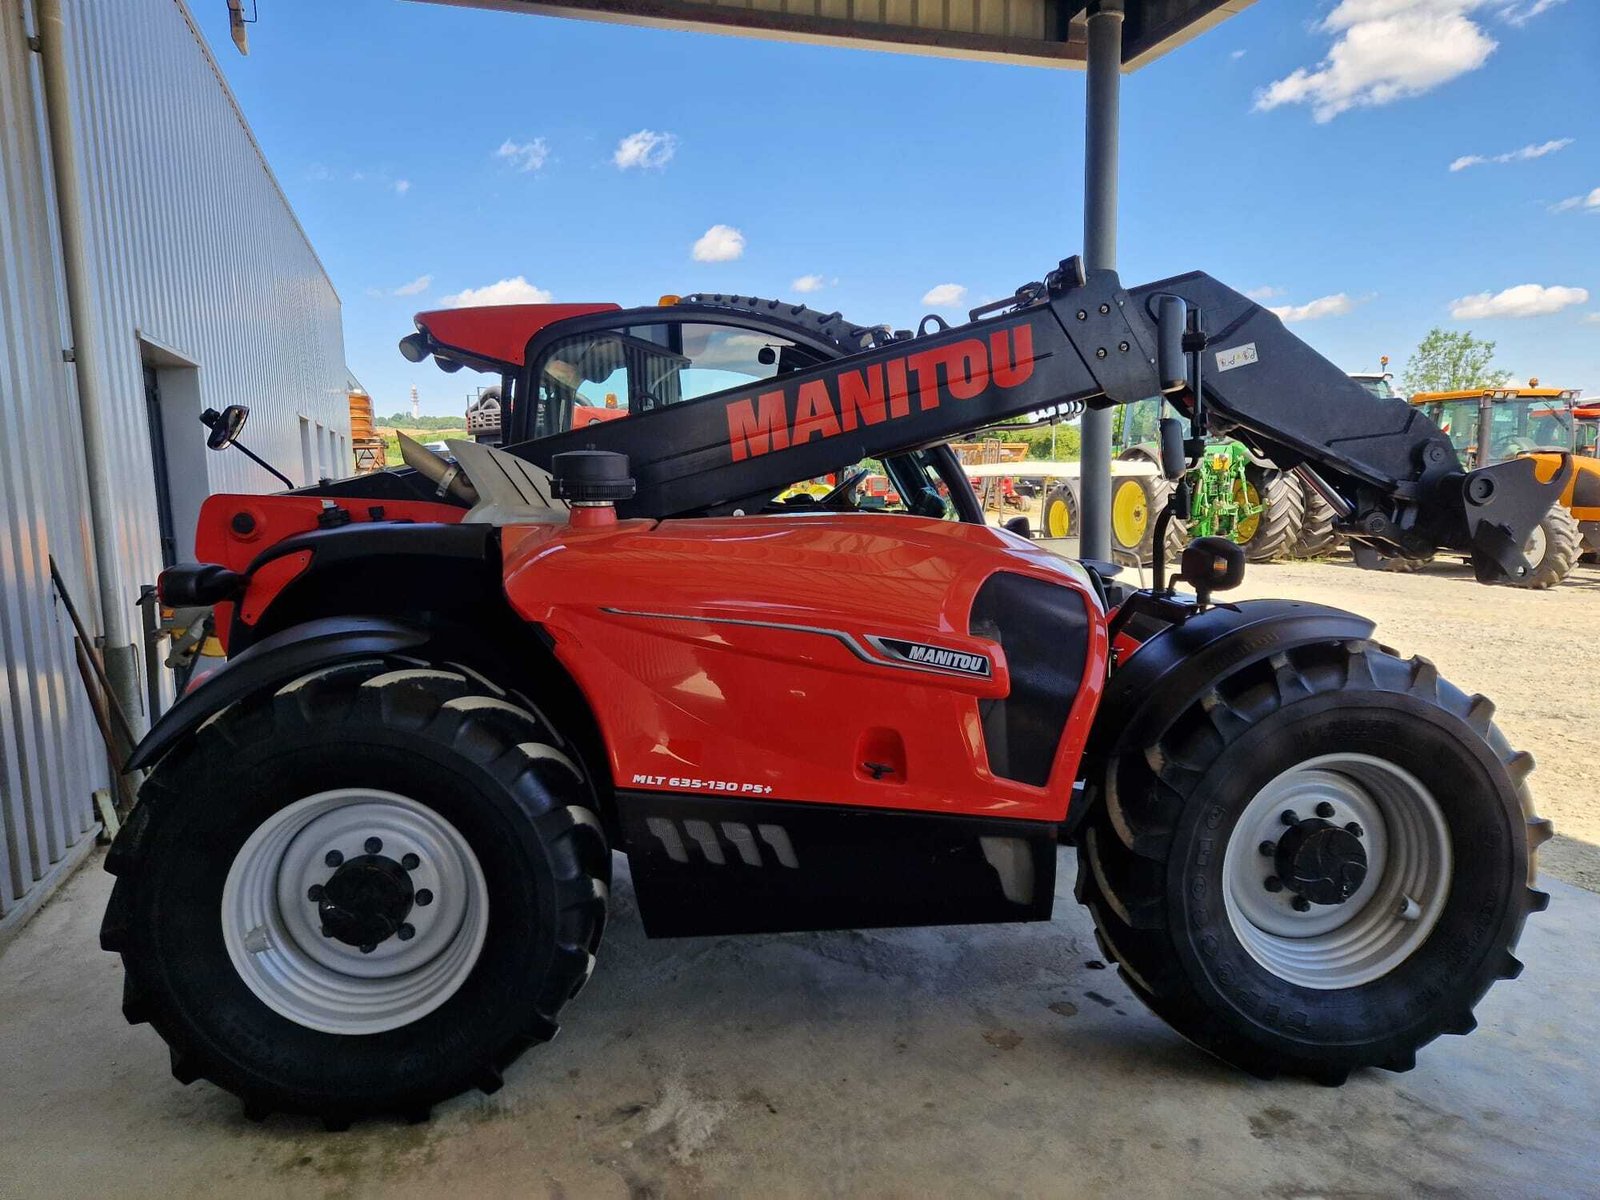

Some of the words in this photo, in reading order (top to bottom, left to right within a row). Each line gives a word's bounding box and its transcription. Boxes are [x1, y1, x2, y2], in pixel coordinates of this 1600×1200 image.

[726, 324, 1035, 463] MANITOU
[908, 646, 983, 671] MANITOU
[632, 774, 667, 786] MLT
[668, 777, 739, 791] 635-130
[741, 783, 773, 794] PS+
